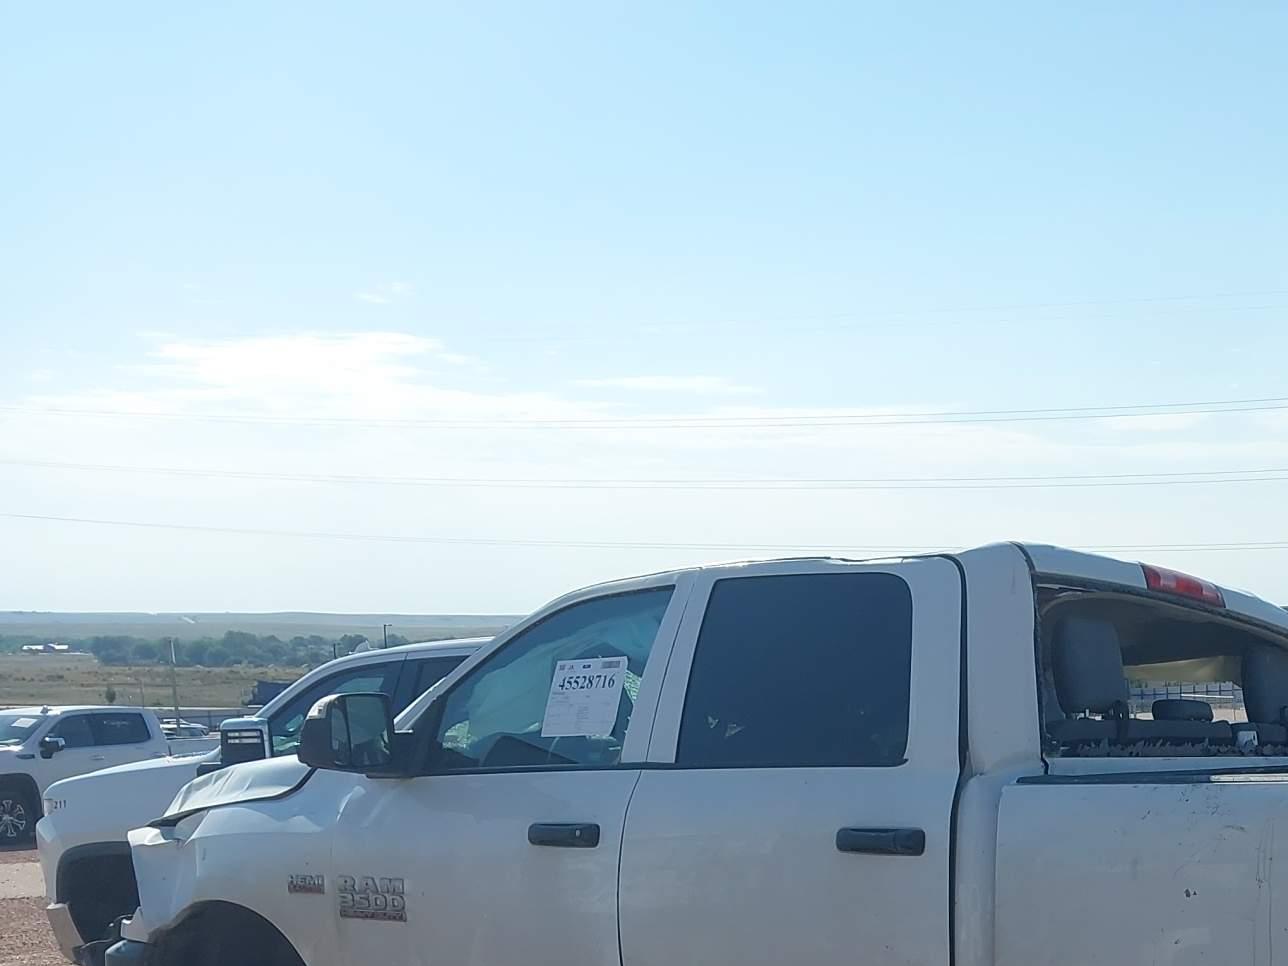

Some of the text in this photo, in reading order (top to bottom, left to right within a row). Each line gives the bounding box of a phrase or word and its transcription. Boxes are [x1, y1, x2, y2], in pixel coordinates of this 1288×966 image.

[558, 673, 616, 690] 45528716
[288, 875, 325, 886] HEMI
[337, 875, 405, 894] RAM
